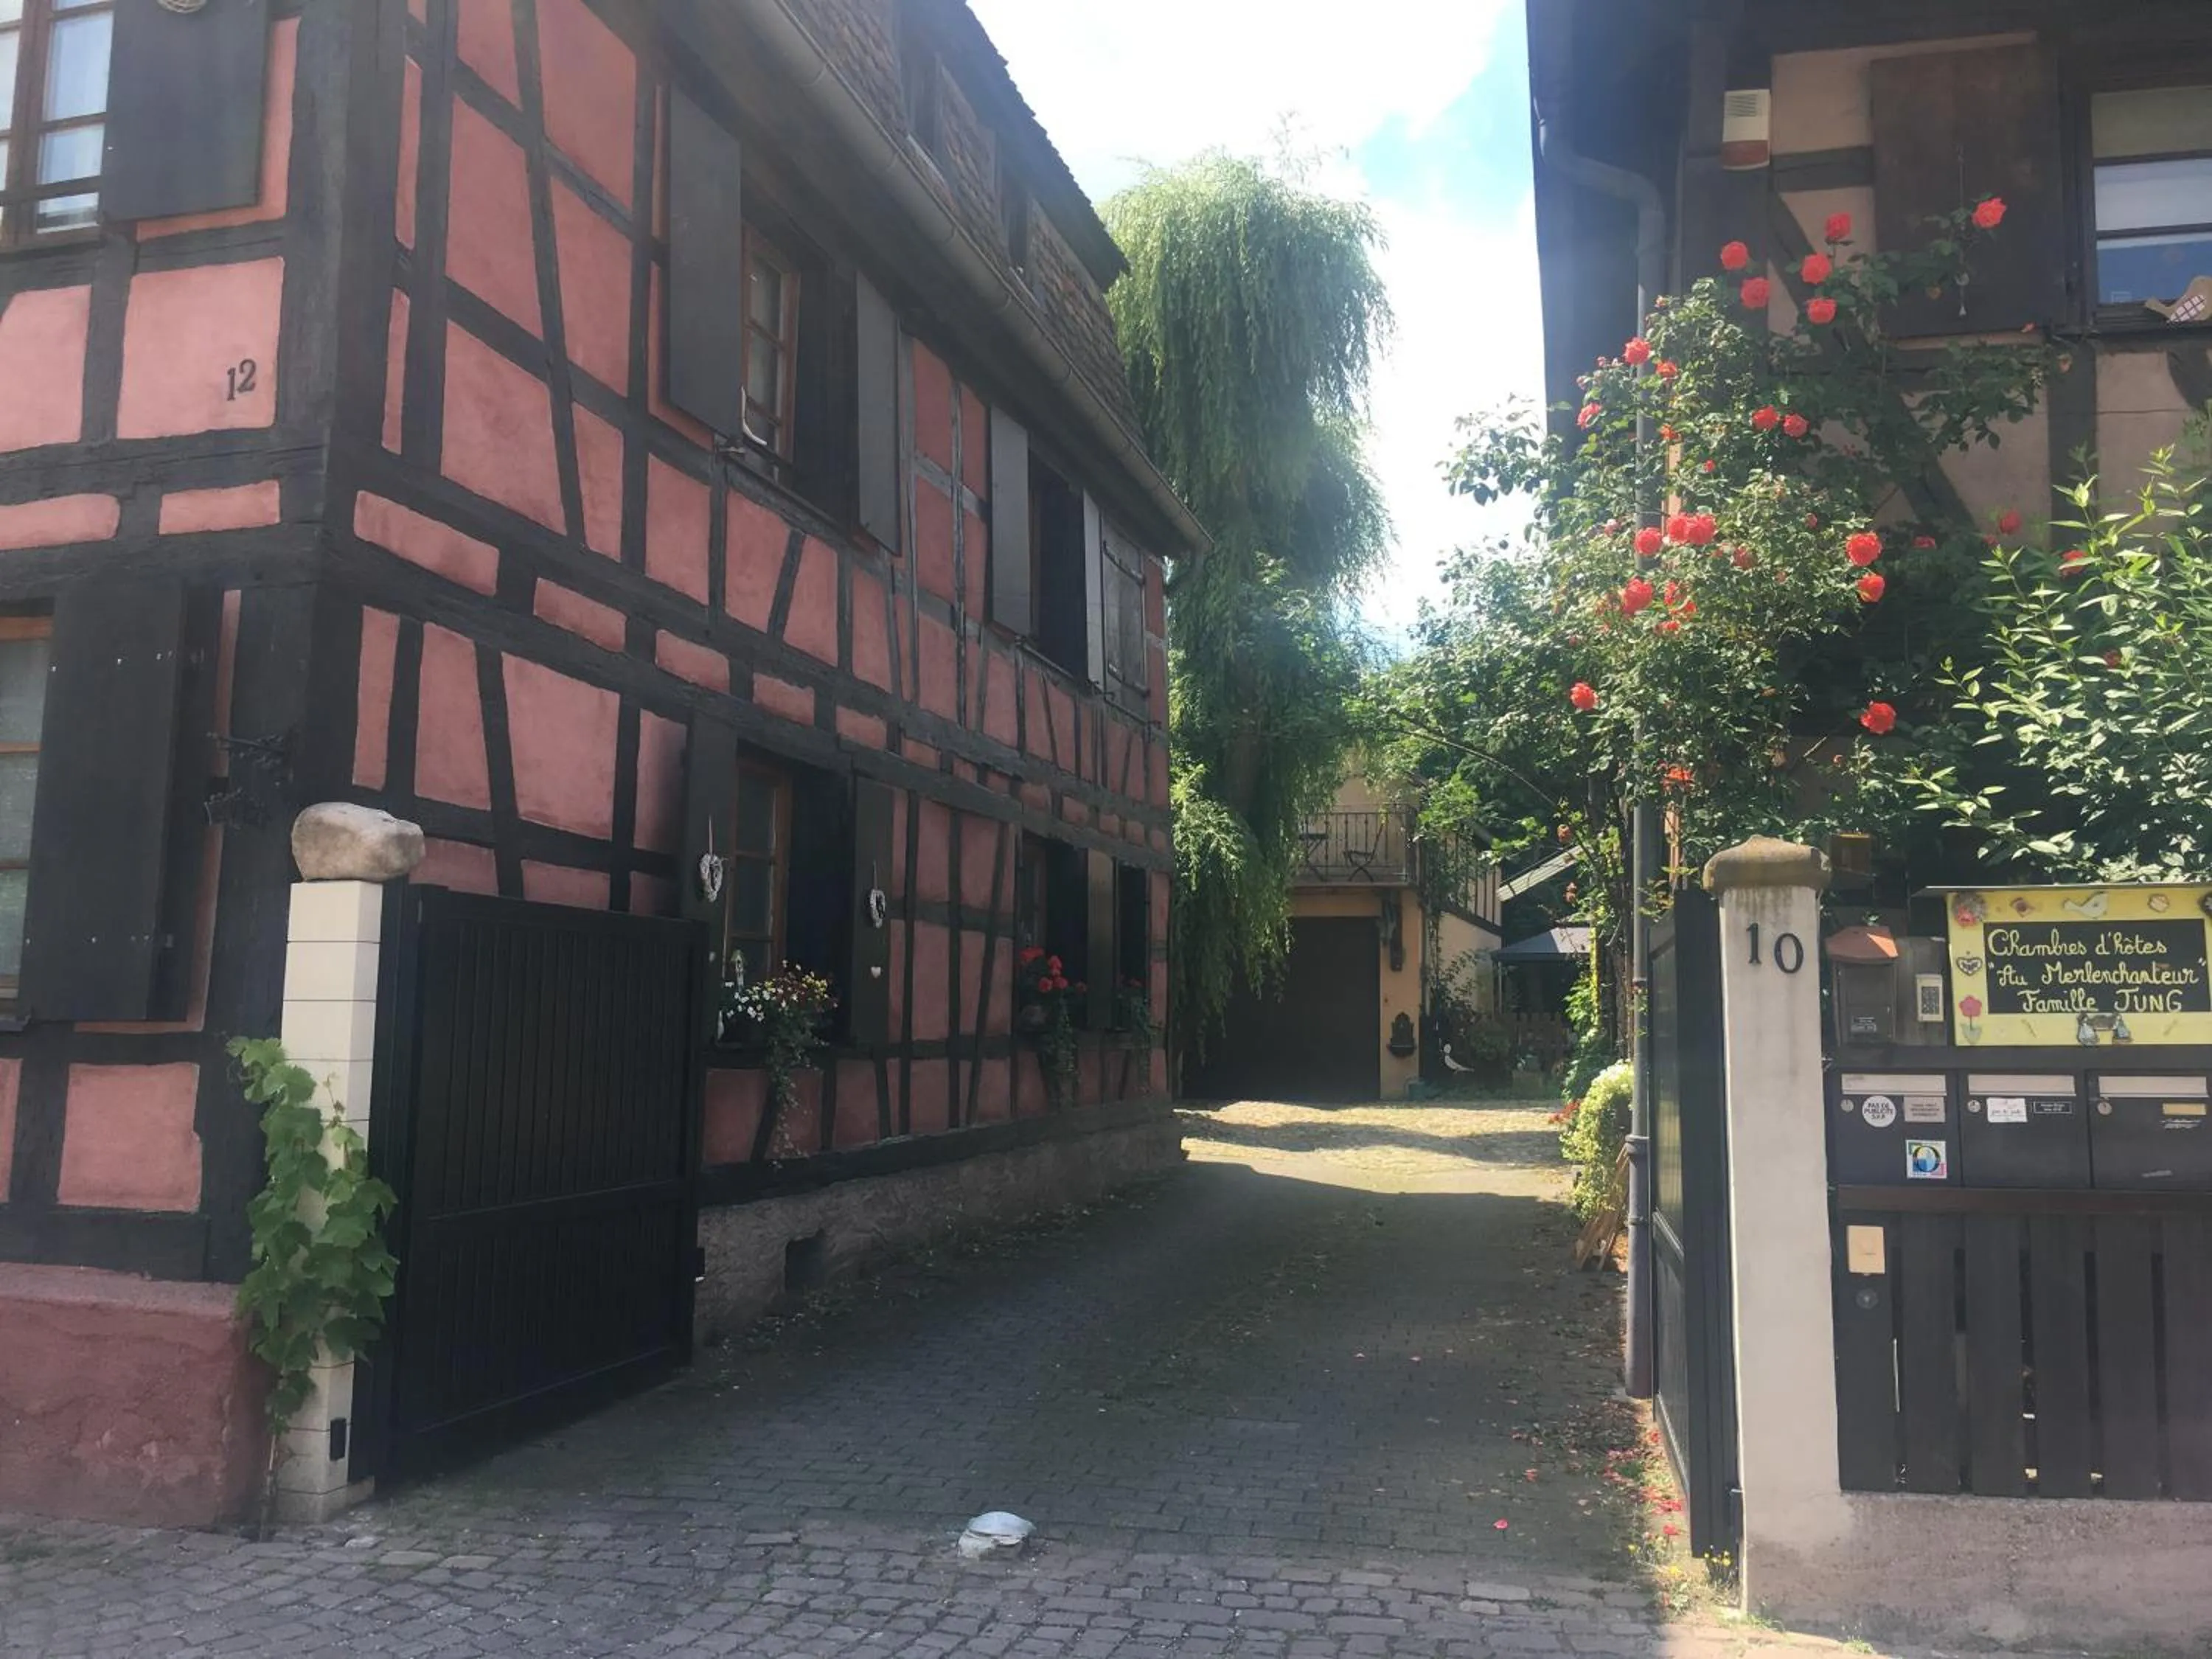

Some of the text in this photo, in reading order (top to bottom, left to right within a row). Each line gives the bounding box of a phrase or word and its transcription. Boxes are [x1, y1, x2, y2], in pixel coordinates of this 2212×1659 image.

[226, 358, 257, 400] 12
[1746, 922, 1804, 973] 10
[1987, 928, 2168, 956] Chambres d'hôtes
[2017, 987, 2183, 1012] Famille JUNG
